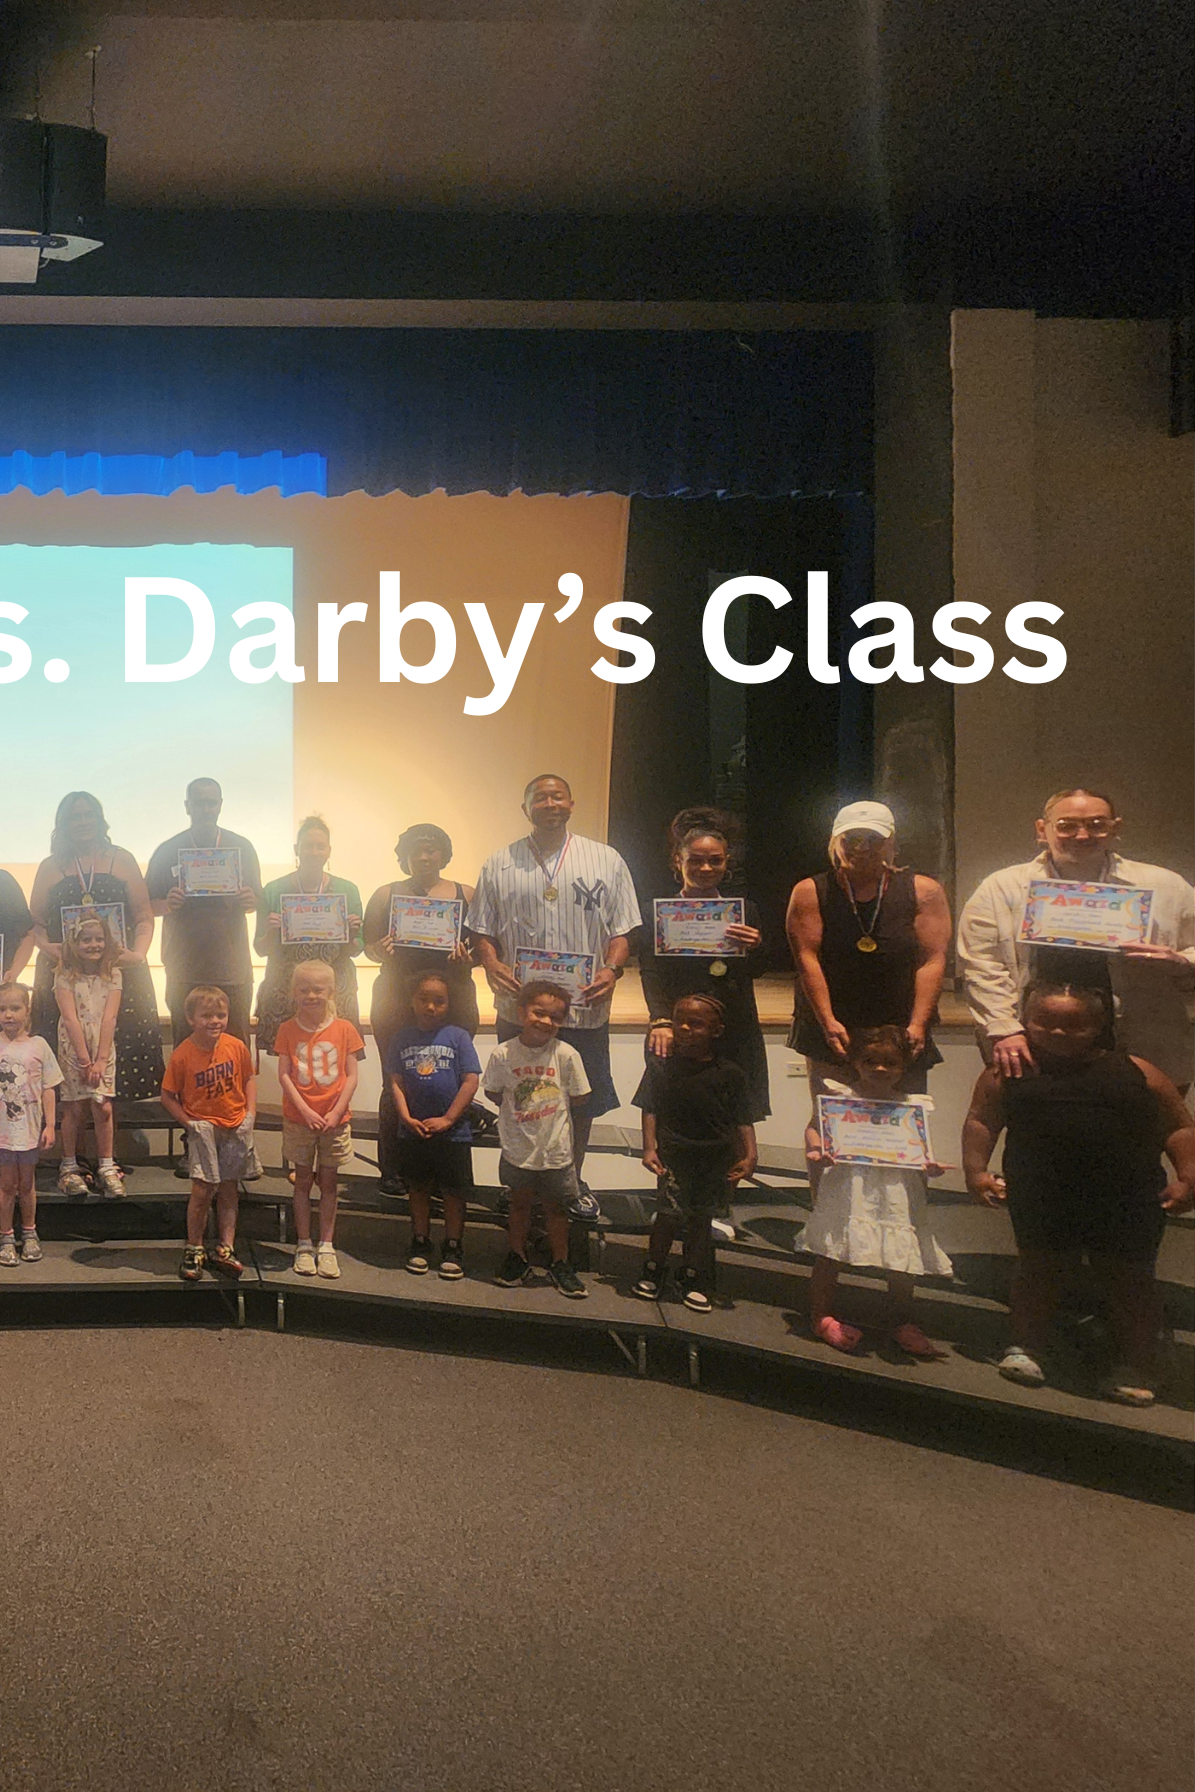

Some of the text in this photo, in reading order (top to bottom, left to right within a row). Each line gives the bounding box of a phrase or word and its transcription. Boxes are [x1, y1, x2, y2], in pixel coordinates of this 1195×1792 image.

[1050, 893, 1122, 911] Award
[672, 910, 722, 922] Award
[529, 959, 575, 974] Award
[194, 1060, 234, 1089] BORN
[512, 1066, 555, 1078] TACO
[841, 1109, 900, 1127] Award
